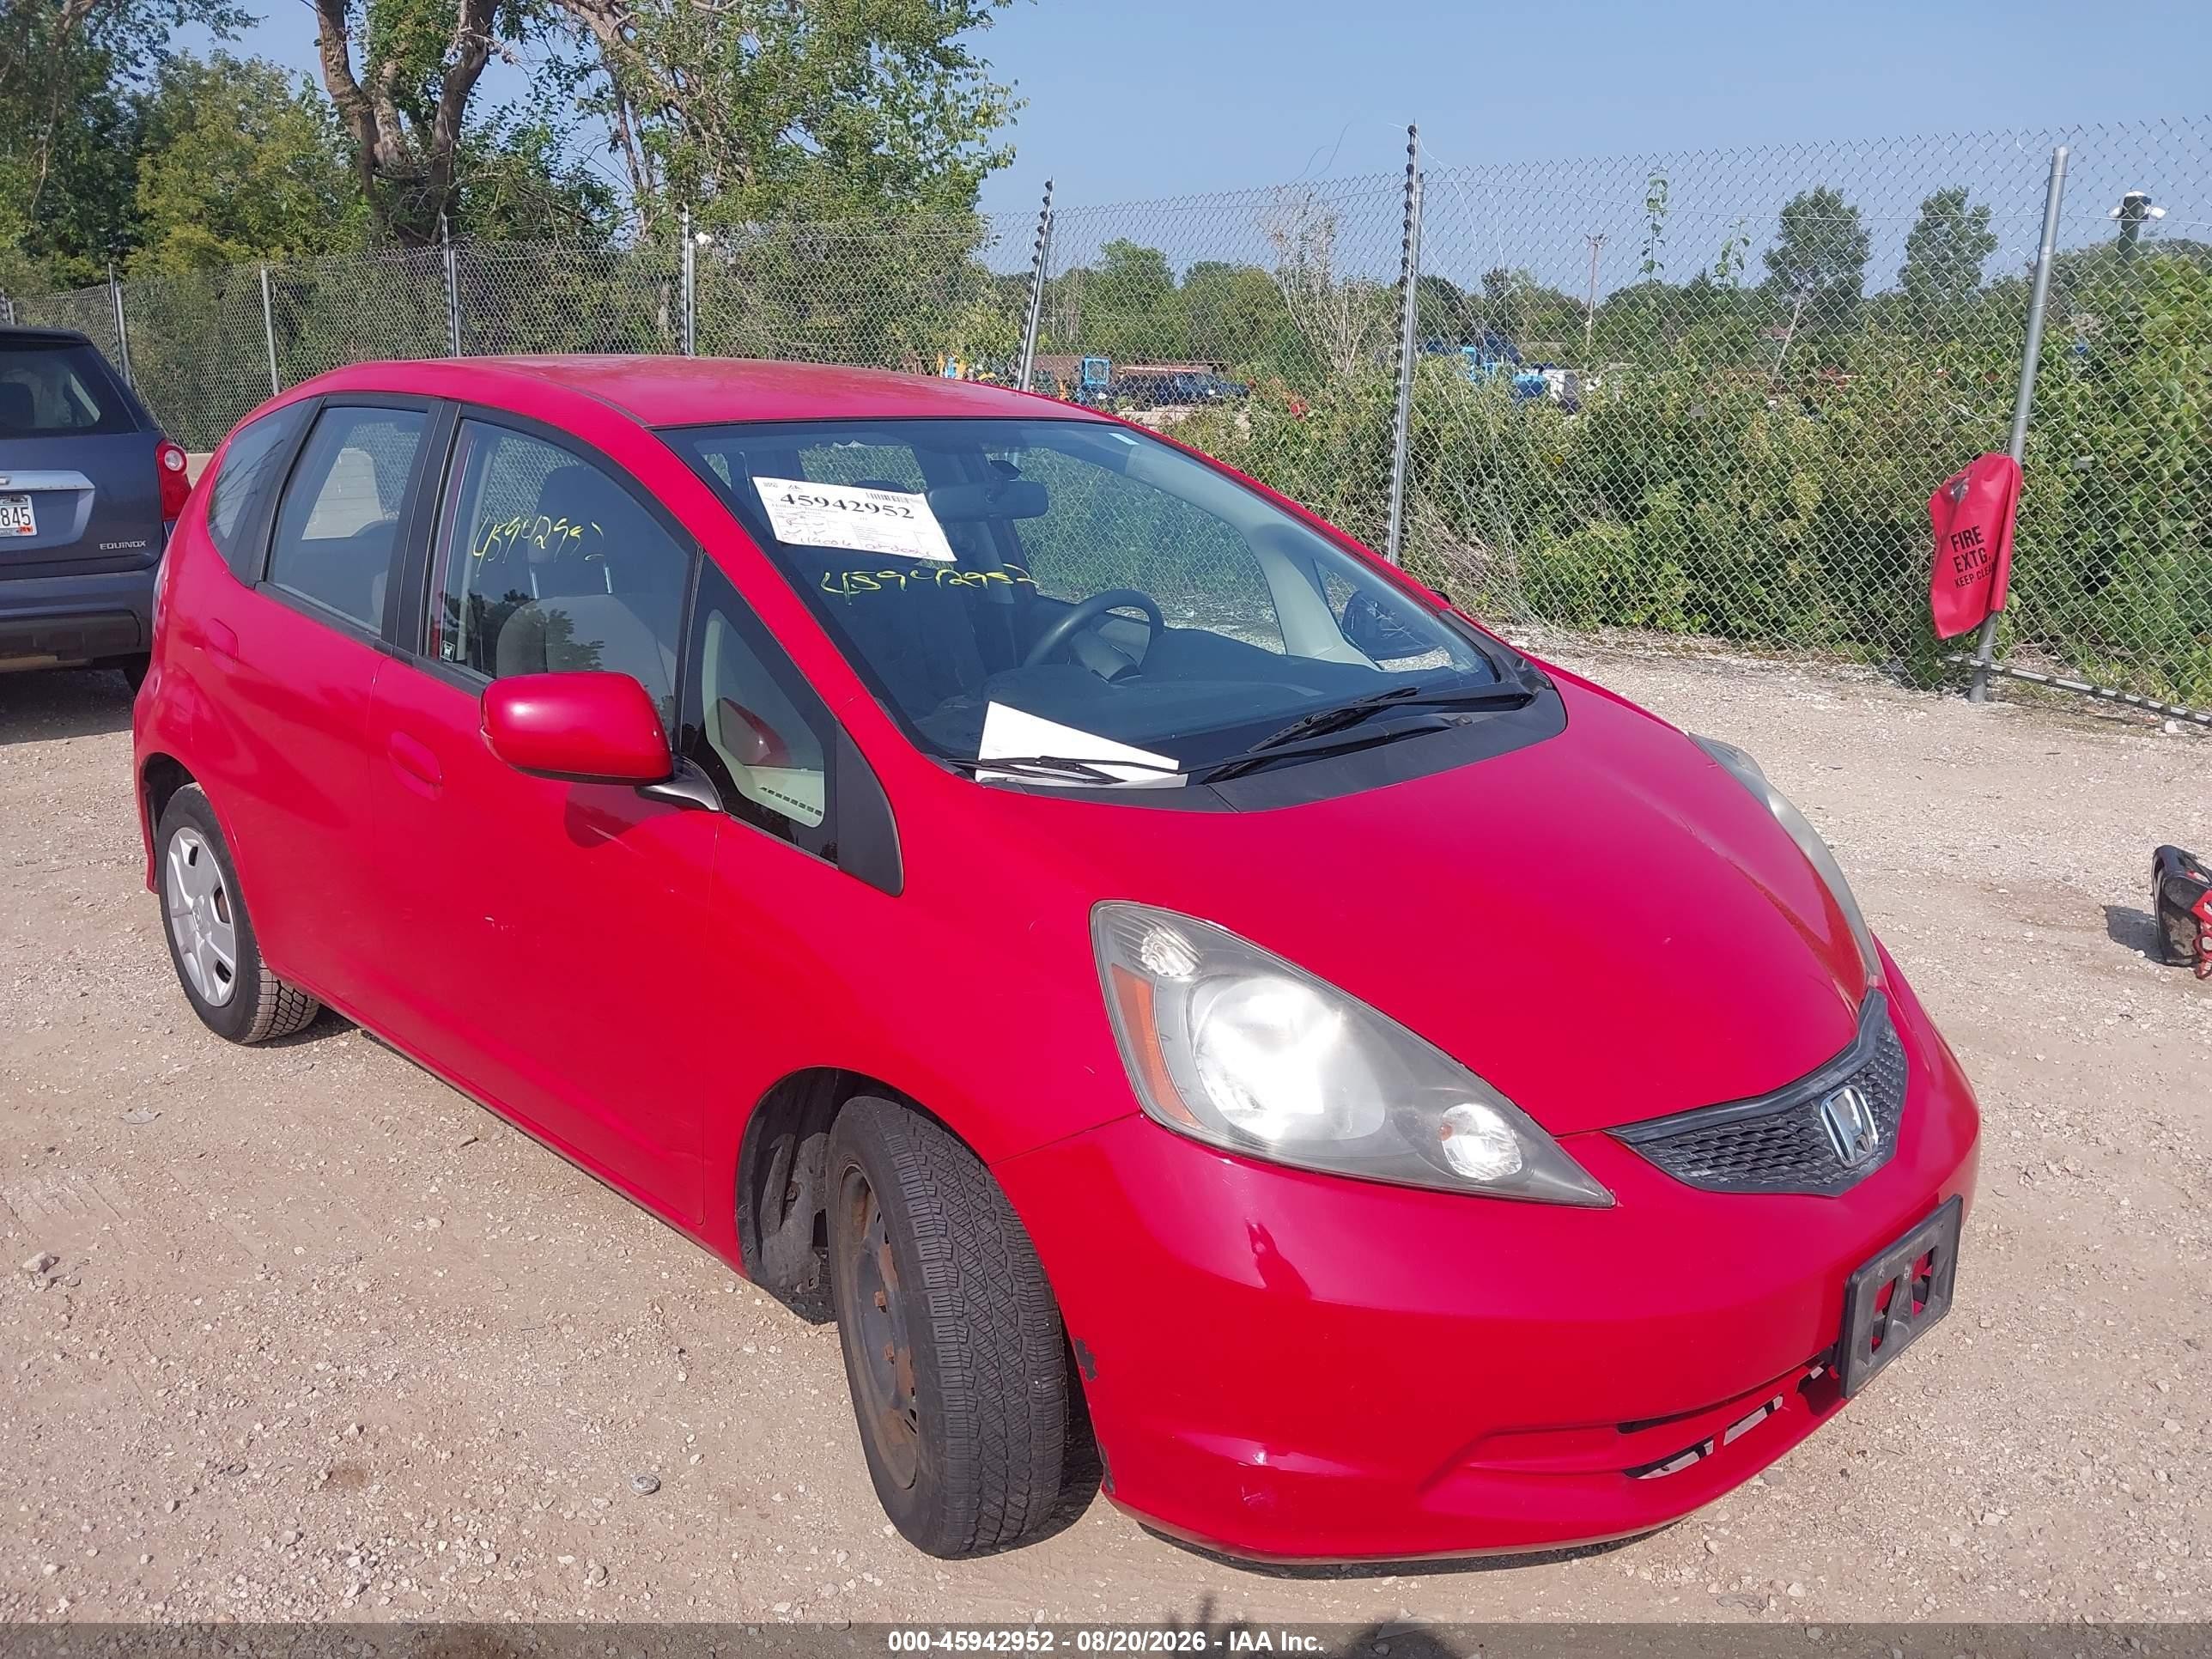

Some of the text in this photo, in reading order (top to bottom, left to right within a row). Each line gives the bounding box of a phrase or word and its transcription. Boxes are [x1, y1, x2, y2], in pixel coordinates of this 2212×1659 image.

[780, 493, 915, 520] 45942952
[100, 540, 147, 550] EQUINOX
[1950, 525, 1984, 553] FIRE
[1953, 547, 1991, 574] EXTG.
[1954, 573, 1974, 589] KEEP
